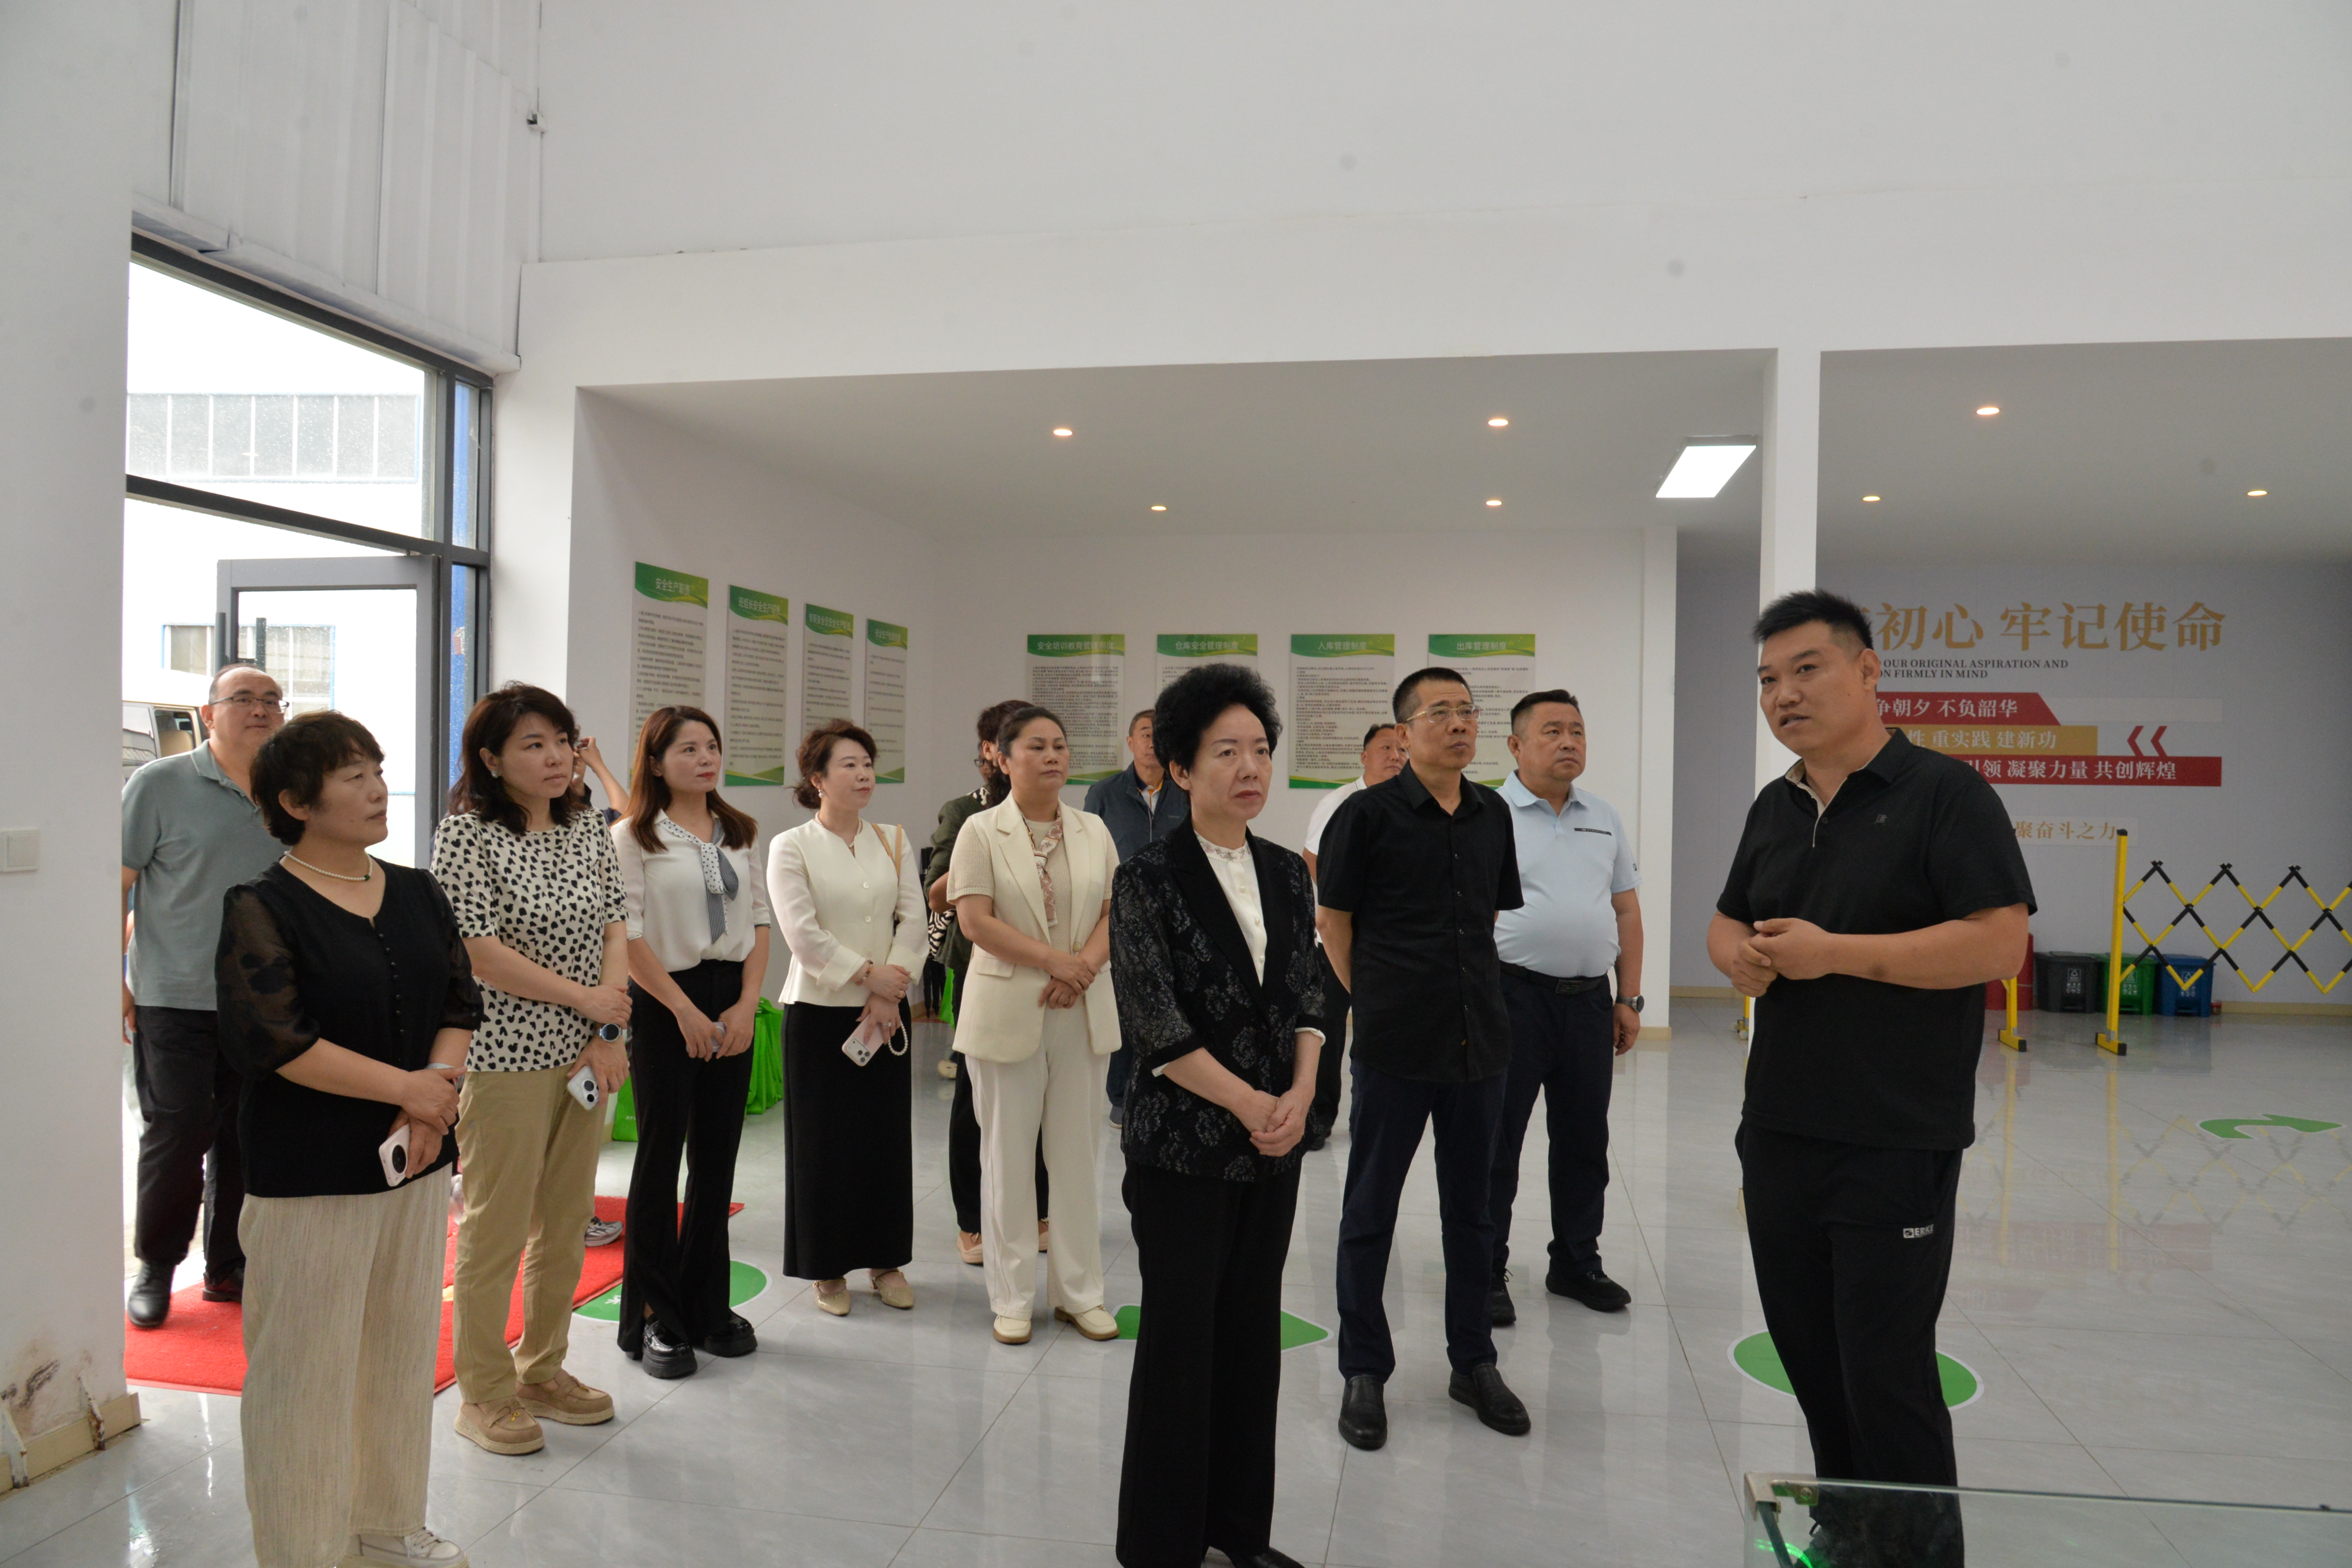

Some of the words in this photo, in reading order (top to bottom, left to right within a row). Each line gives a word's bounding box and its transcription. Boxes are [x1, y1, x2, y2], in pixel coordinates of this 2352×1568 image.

[655, 578, 690, 596] 安全生产职责
[1861, 602, 1983, 651] 初心
[2000, 602, 2226, 652] 牢记使命
[1175, 641, 1239, 650] 仓库安全管理制度
[1318, 641, 1367, 650] 入库管理制度
[1457, 641, 1506, 650] 出库管理制度
[1883, 659, 1908, 668] OUR
[1910, 659, 1967, 668] ORIGINAL
[1969, 659, 2040, 668] ASPIRATION
[2043, 659, 2068, 668] AND
[1877, 699, 1931, 717] 争朝夕
[1938, 699, 2018, 718] 不负韶华
[1932, 730, 1990, 748] 重实践
[1997, 730, 2057, 749] 建新功
[2007, 761, 2088, 779] 凝聚力量
[2094, 761, 2177, 780] 共创辉煌
[1914, 1224, 1934, 1236] ERKE
